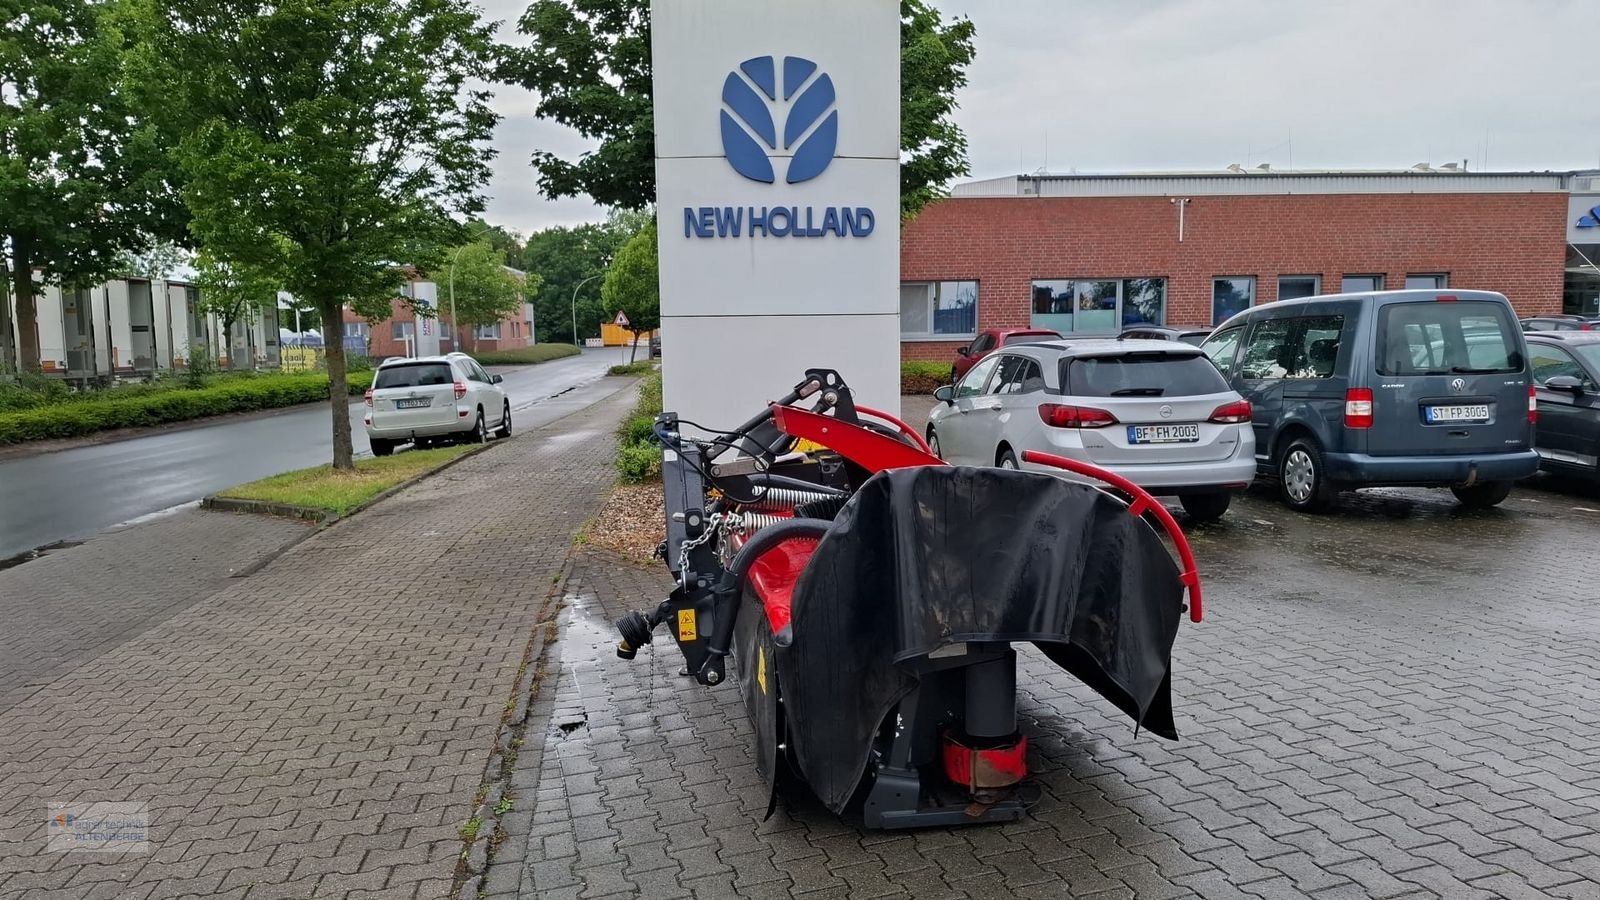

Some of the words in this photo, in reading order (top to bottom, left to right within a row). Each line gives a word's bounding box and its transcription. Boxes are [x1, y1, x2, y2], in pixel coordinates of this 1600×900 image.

[684, 207, 743, 238] NEW
[748, 206, 875, 238] HOLLAND
[1433, 409, 1444, 418] ST
[1451, 409, 1462, 418] FP
[1465, 407, 1487, 418] 3005
[1136, 427, 1149, 439] BF
[1156, 427, 1170, 438] FH
[1172, 426, 1197, 437] 2003
